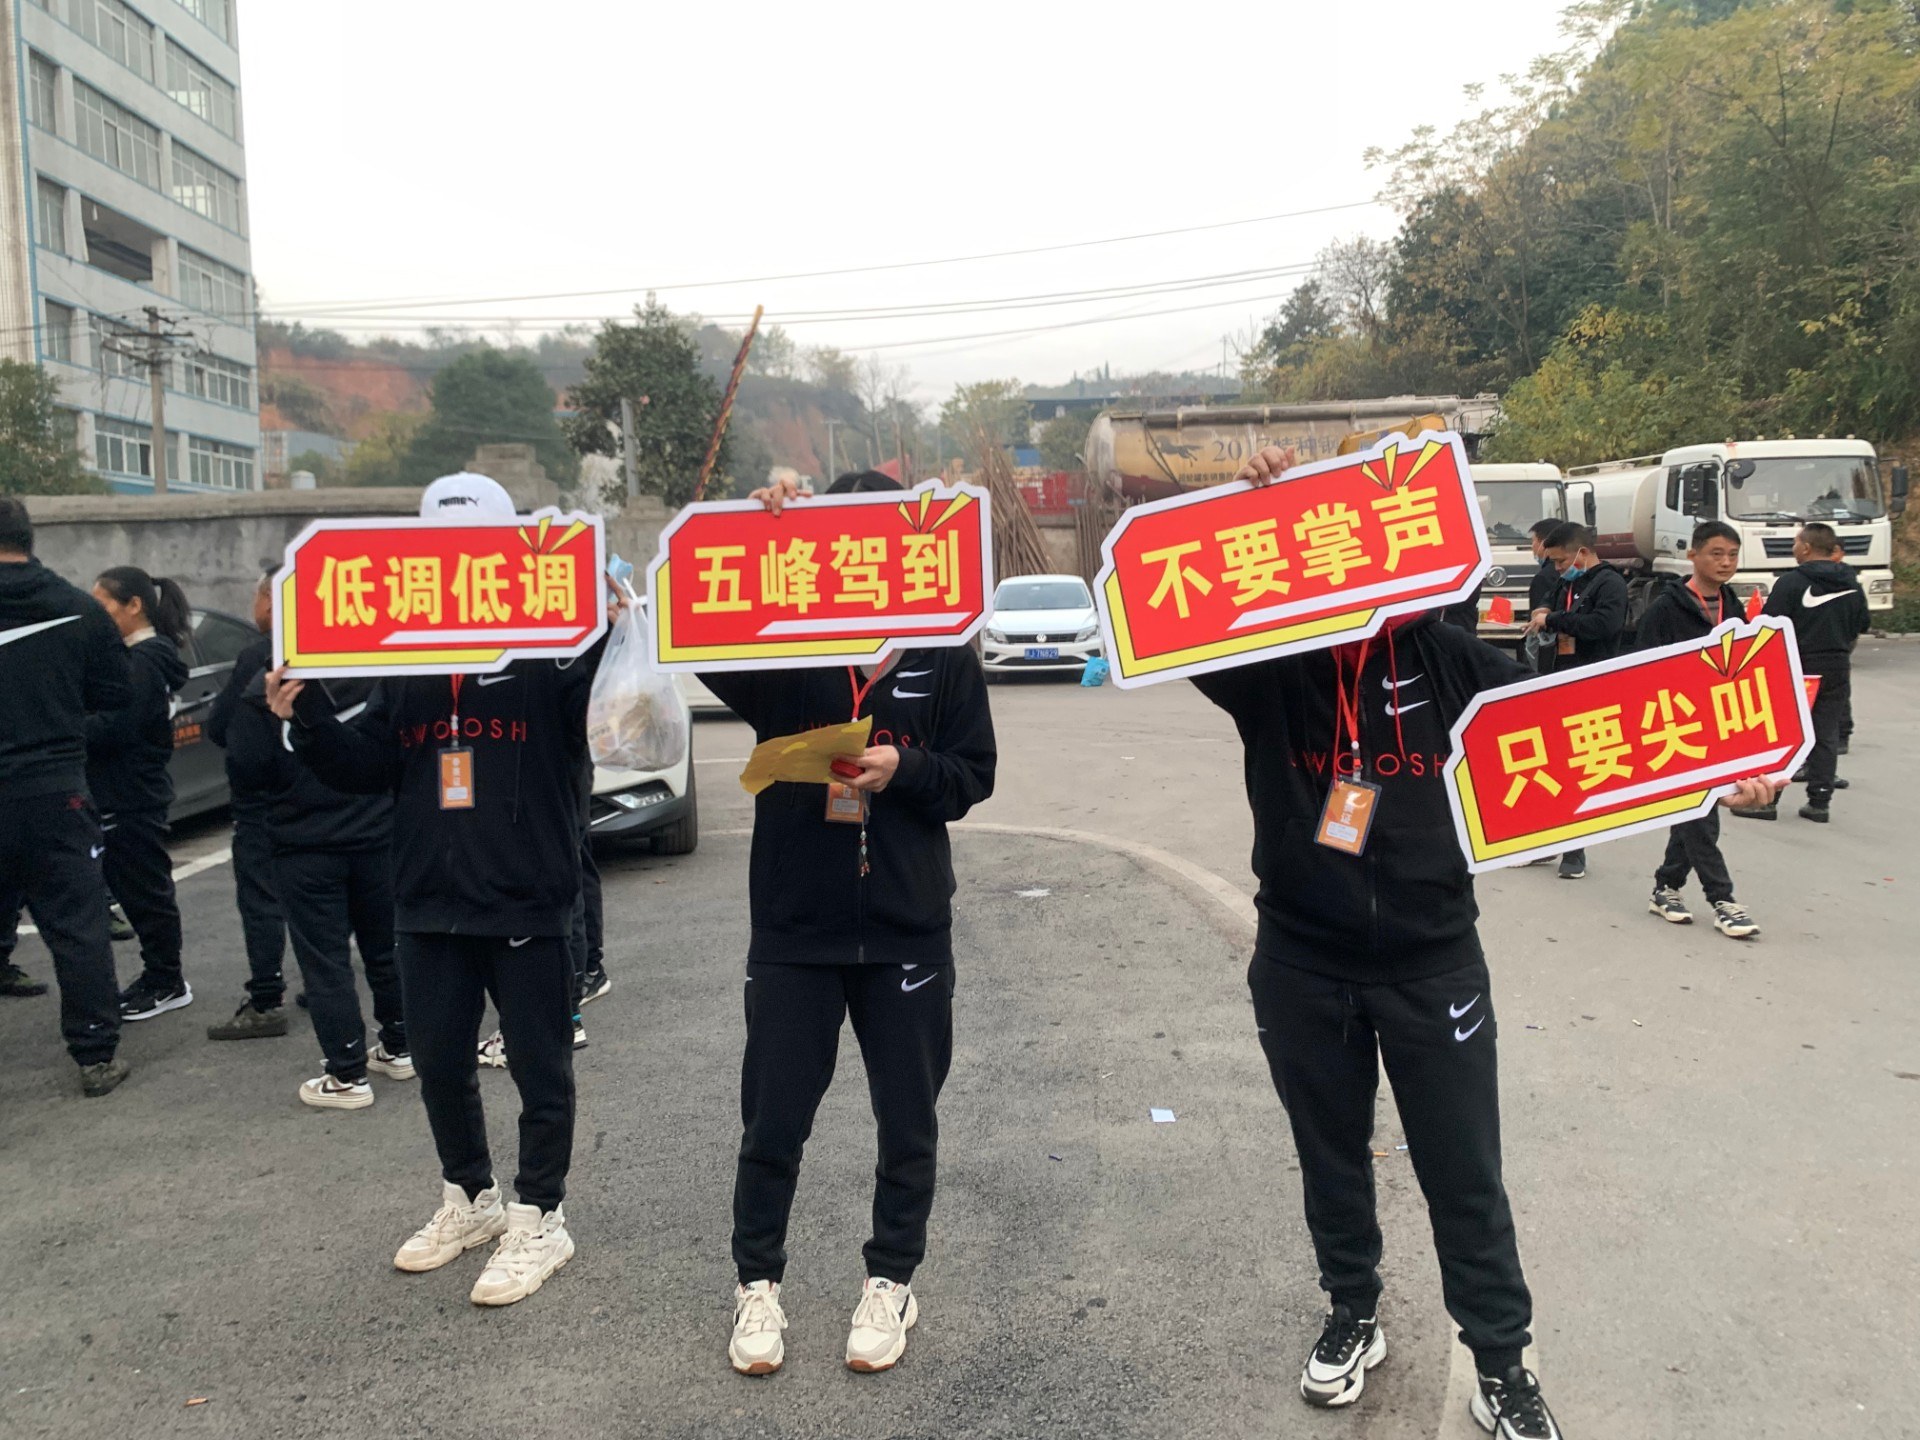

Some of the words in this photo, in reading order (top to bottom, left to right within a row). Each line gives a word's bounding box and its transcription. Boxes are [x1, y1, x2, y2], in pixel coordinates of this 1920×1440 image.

[316, 554, 577, 627] 低调低调
[692, 530, 962, 613] 五峰驾到
[1141, 485, 1444, 618] 不要掌声
[1290, 750, 1449, 778] WOOSH
[1497, 667, 1778, 808] 只要尖叫
